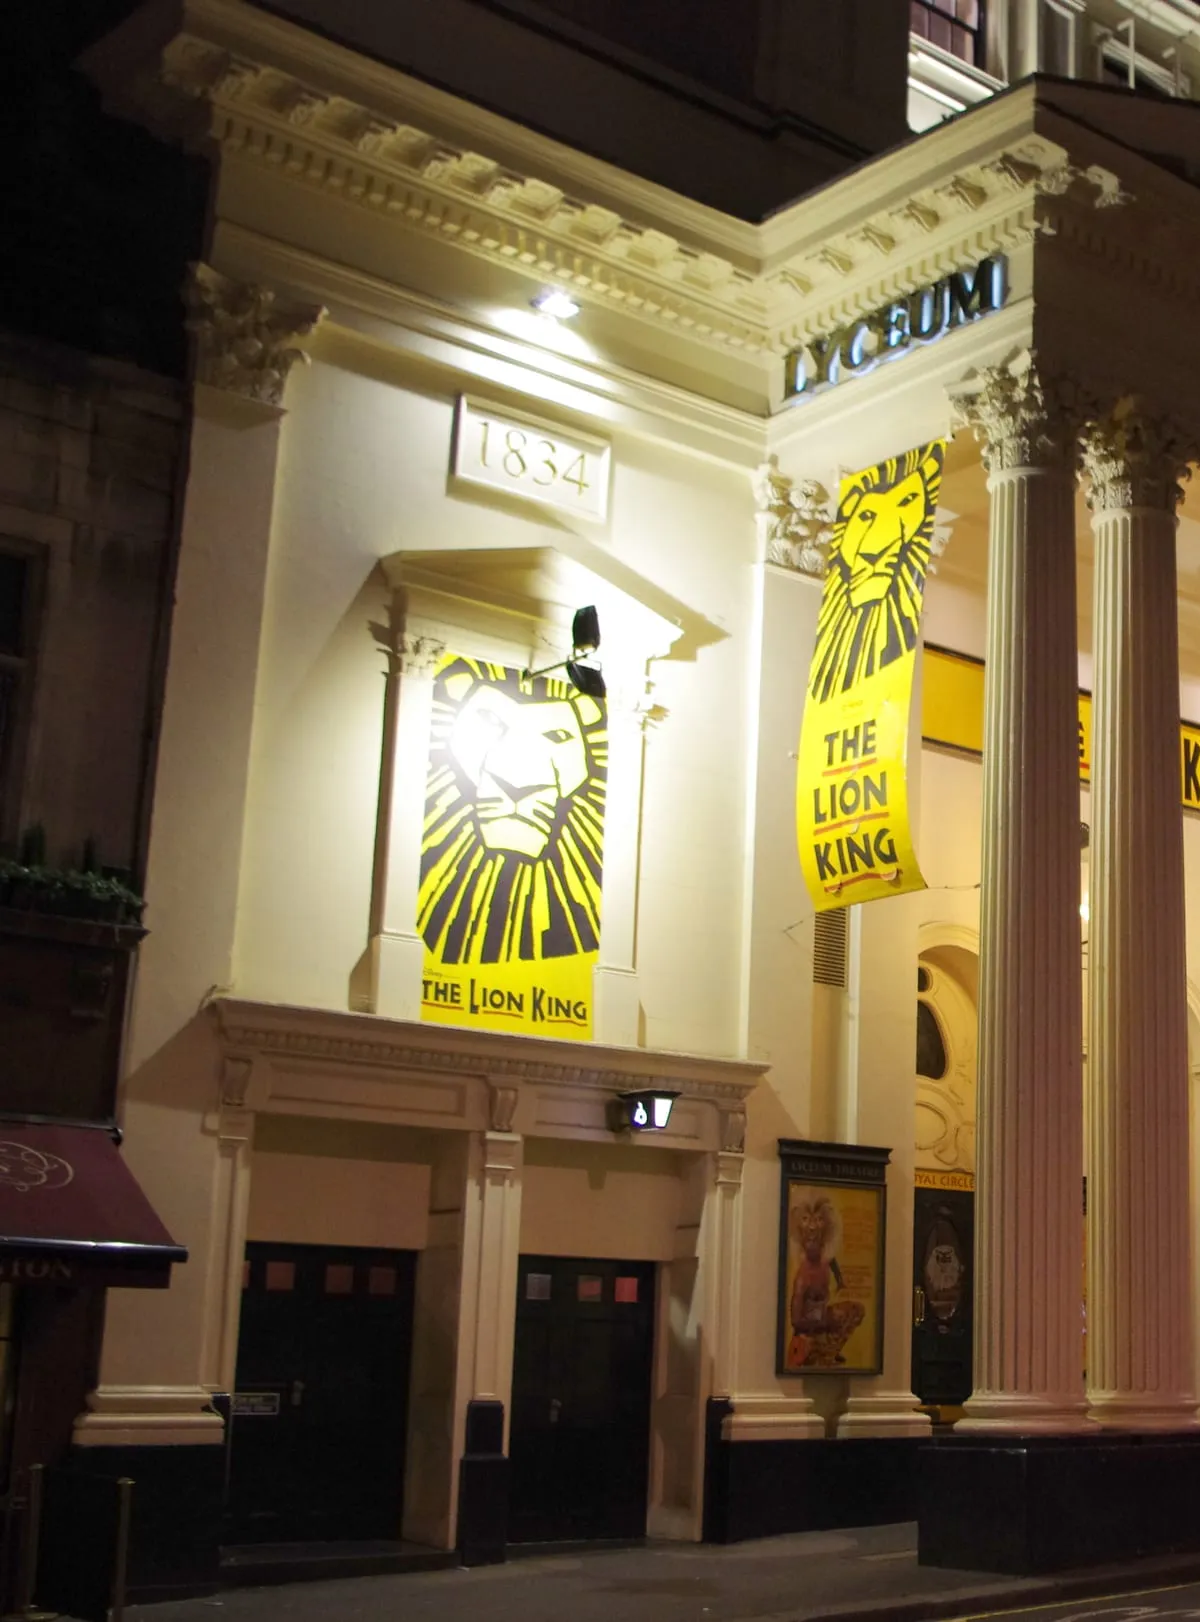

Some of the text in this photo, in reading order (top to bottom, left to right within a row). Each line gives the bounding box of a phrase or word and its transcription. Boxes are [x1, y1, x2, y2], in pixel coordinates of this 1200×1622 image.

[784, 252, 1009, 402] LYCEUM
[477, 421, 589, 496] 1834
[824, 718, 877, 767] THE
[813, 770, 887, 824] LION
[813, 827, 899, 881] KING
[422, 980, 461, 1004] THE
